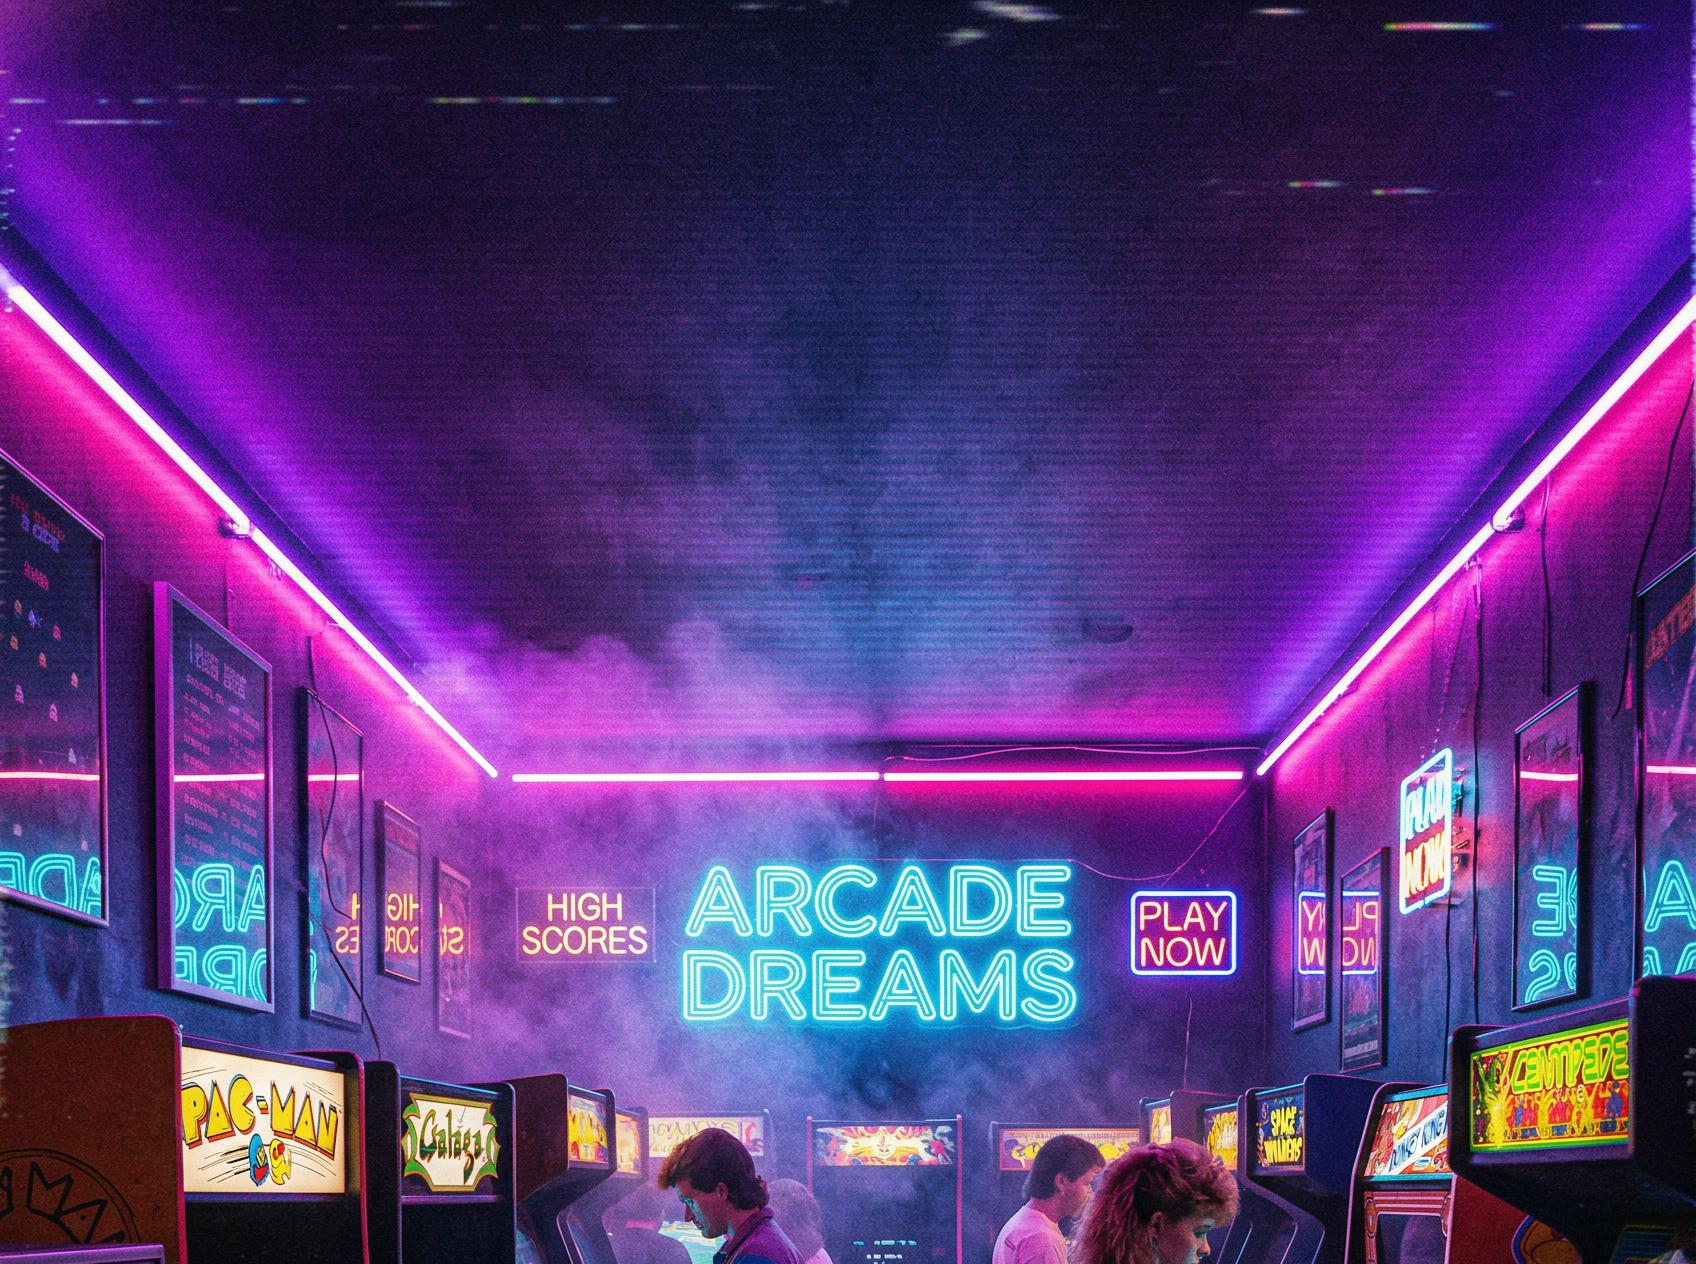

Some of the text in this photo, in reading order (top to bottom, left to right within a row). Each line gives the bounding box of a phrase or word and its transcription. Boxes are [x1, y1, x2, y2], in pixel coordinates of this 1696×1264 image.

[547, 892, 623, 921] HIGH
[685, 864, 1072, 937] ARCADE
[1139, 901, 1228, 931] PLAY
[522, 925, 649, 955] SCORES
[1140, 937, 1226, 967] NOW
[683, 949, 1077, 1021] DREAMS
[181, 1074, 338, 1160] PAC-MAN
